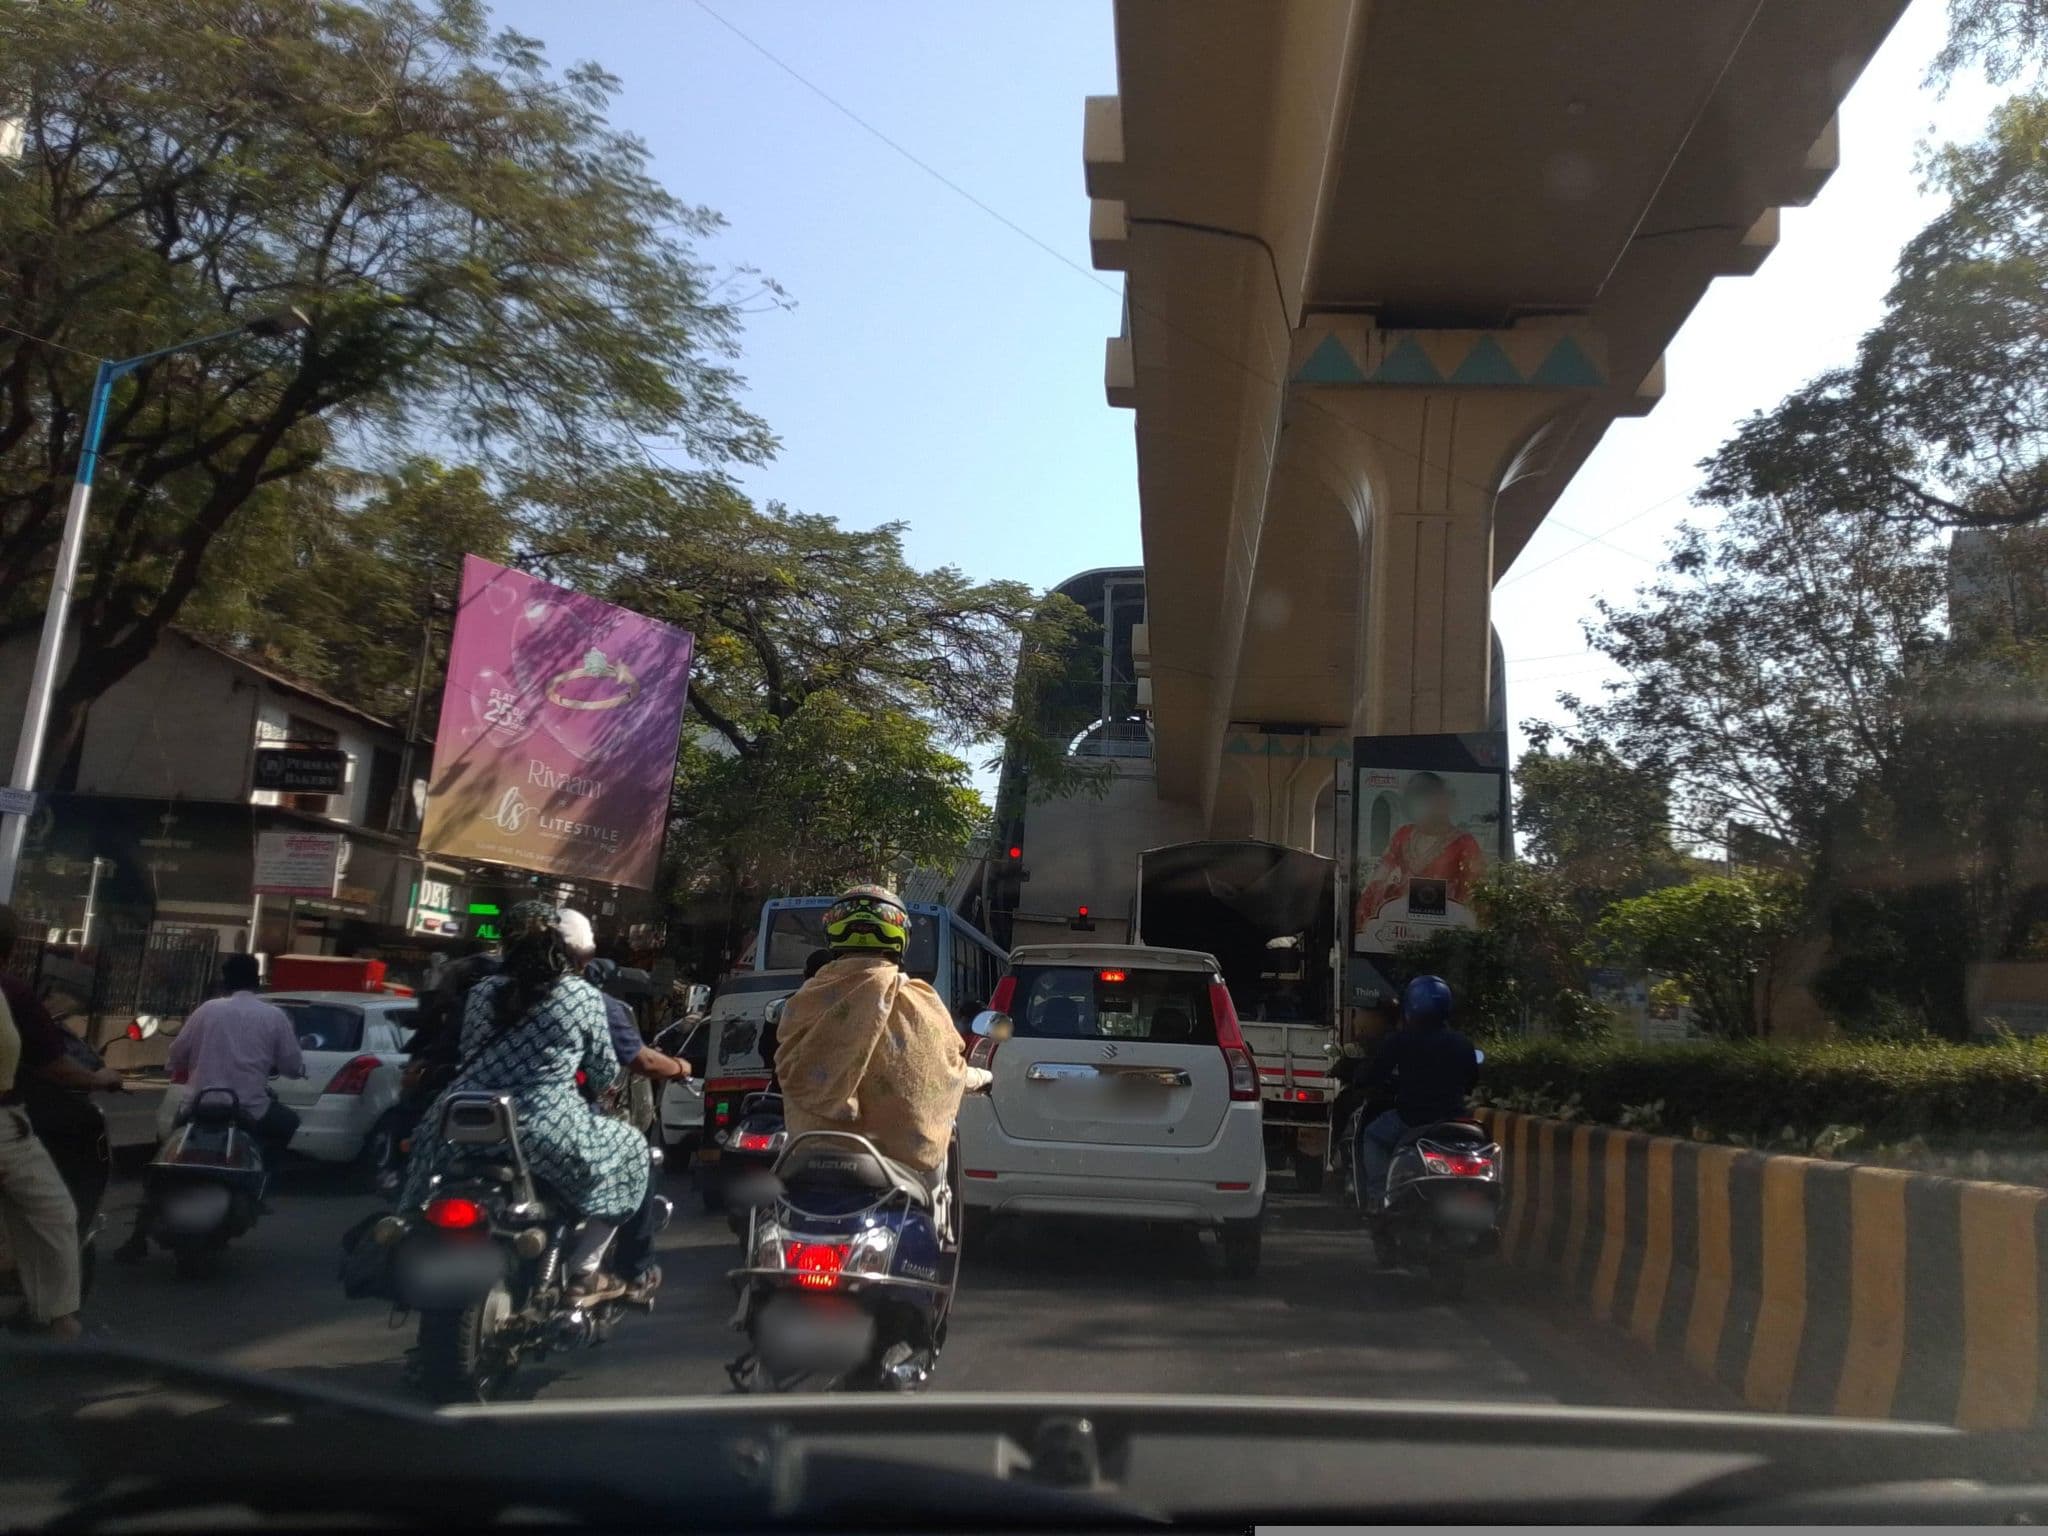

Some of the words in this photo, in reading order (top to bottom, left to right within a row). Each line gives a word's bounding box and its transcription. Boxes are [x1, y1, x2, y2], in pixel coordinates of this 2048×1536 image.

[488, 687, 516, 703] FLAT
[483, 698, 513, 726] 25
[1355, 987, 1381, 998] Think
[808, 1159, 858, 1172] SUZUKI
